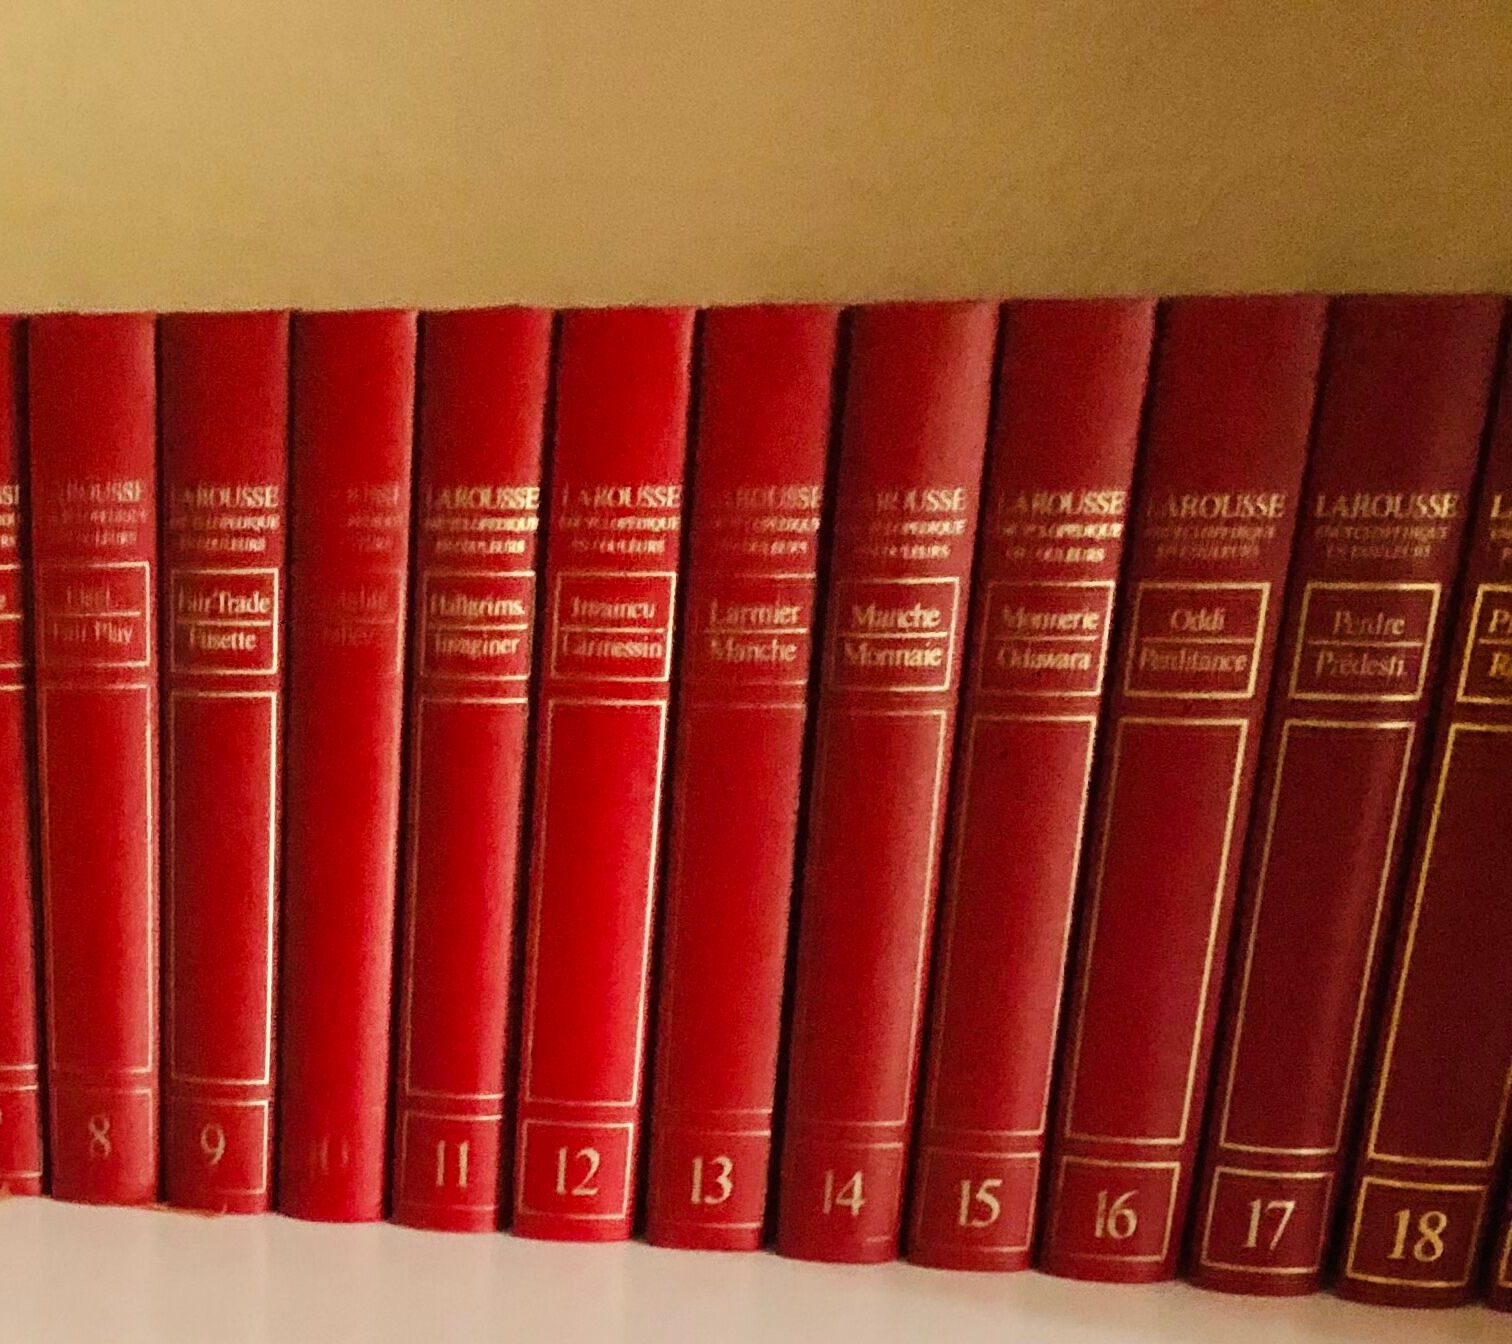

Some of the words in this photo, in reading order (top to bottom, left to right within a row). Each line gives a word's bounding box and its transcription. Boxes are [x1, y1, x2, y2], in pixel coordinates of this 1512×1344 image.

[1316, 492, 1460, 519] LAROUSSE
[219, 590, 270, 614] Trade
[711, 598, 801, 624] Larmier
[852, 602, 941, 628] Manche
[1170, 608, 1226, 631] Oddi
[711, 638, 797, 662] Manche
[844, 640, 944, 667] Monnaie
[88, 1113, 112, 1160] 8
[200, 1122, 226, 1166] 9
[436, 1139, 469, 1189] 11
[555, 1146, 601, 1197] 12
[690, 1155, 734, 1205] 13
[823, 1168, 867, 1217] 14
[959, 1178, 1004, 1228] 15
[1094, 1189, 1138, 1239] 16
[1244, 1198, 1296, 1250] 17
[1387, 1208, 1448, 1262] 18
